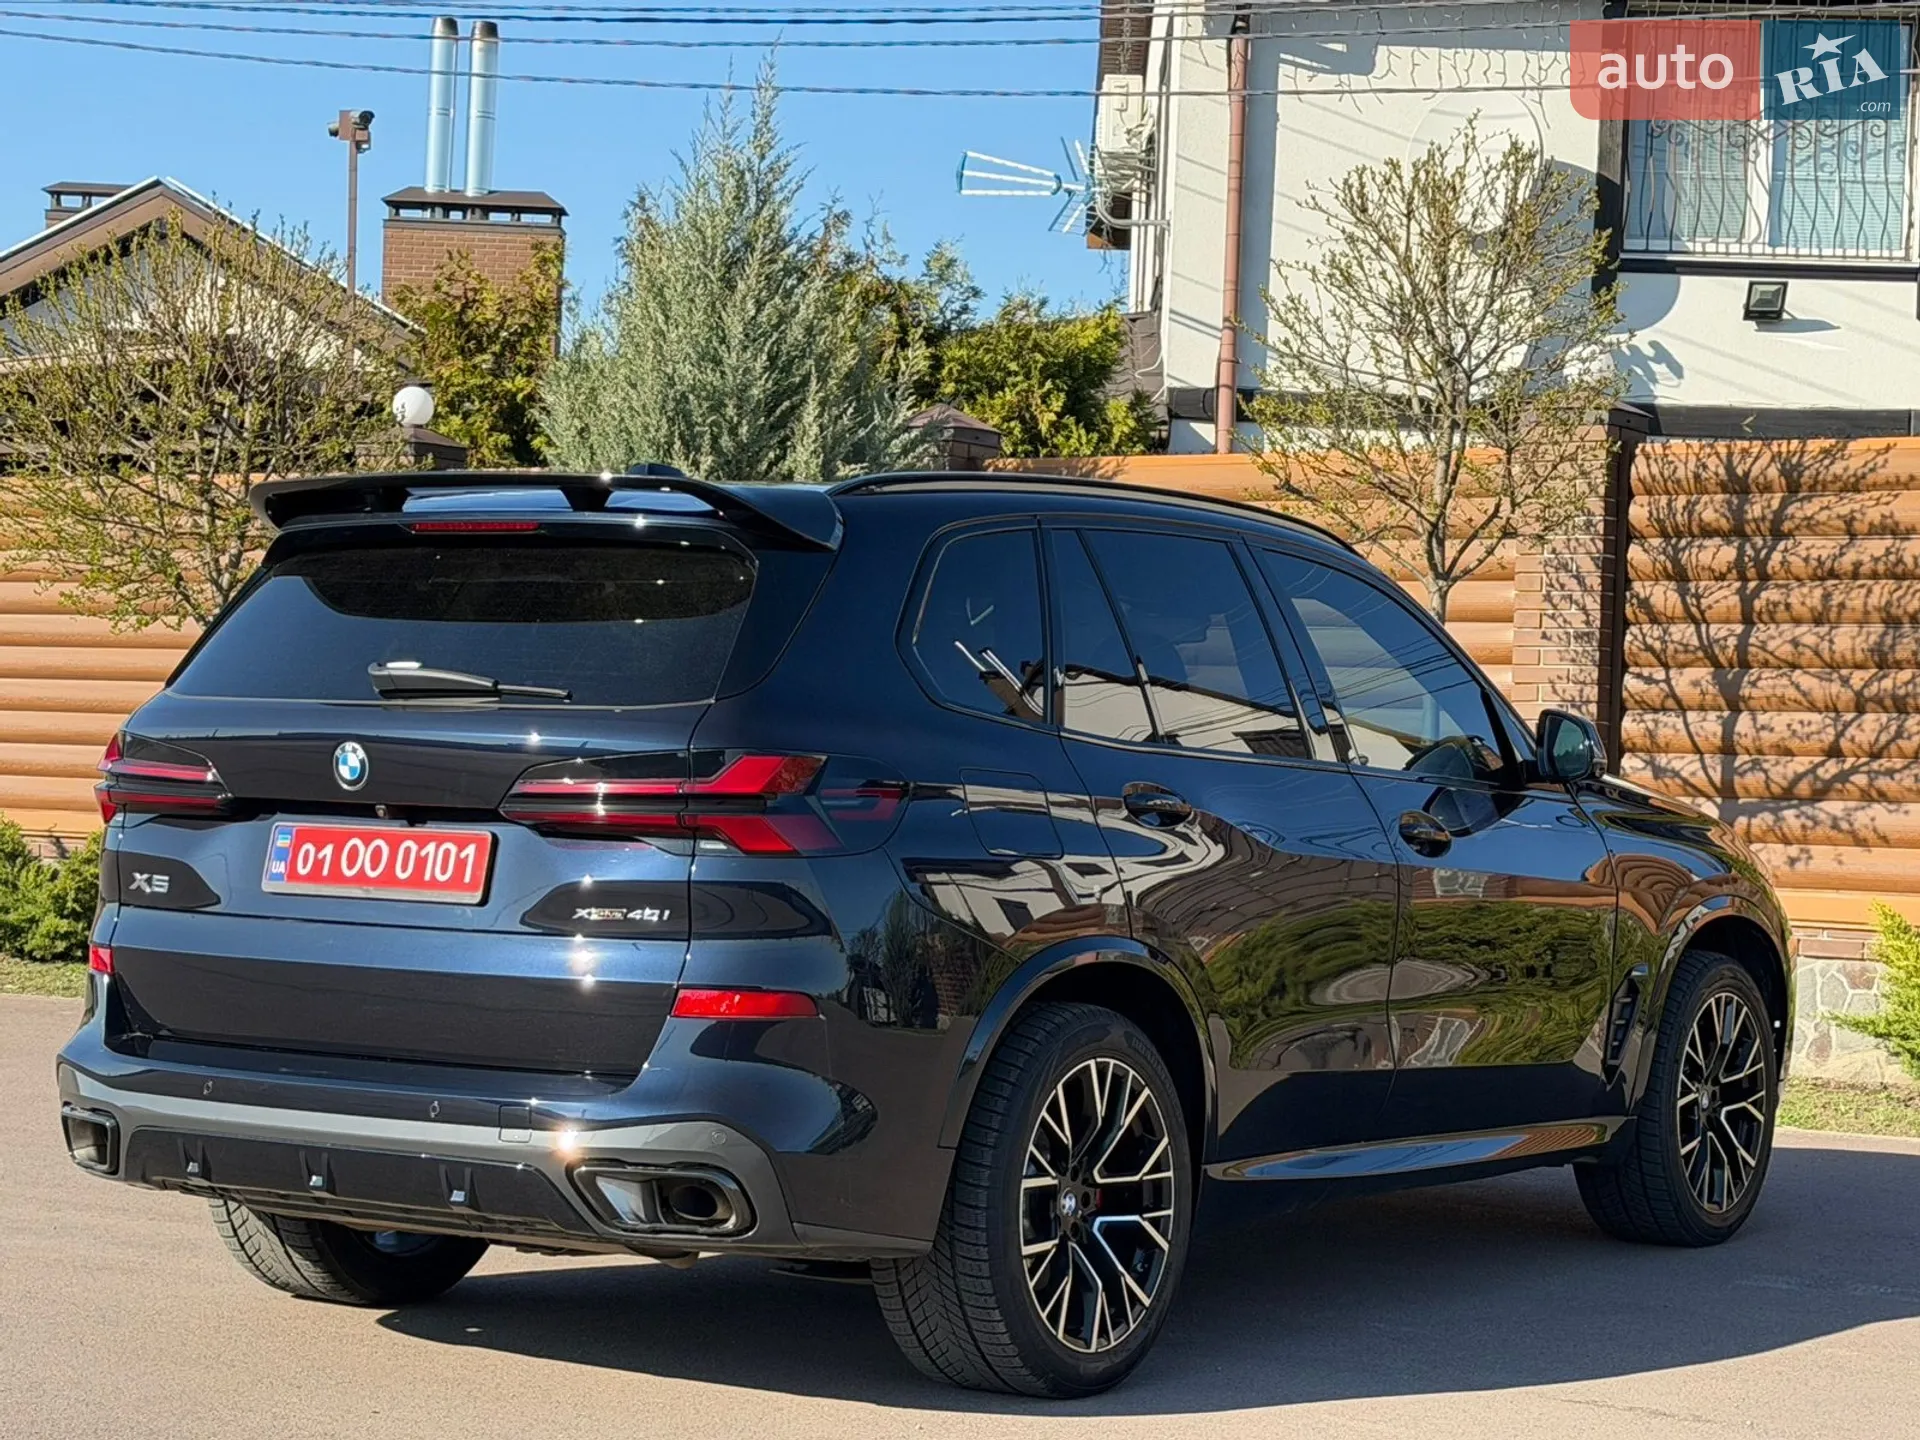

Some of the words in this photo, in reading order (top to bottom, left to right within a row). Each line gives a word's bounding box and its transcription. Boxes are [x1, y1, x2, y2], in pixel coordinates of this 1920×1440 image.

[271, 861, 286, 874] UA
[296, 842, 335, 877] 01
[395, 839, 478, 884] 0101
[128, 872, 170, 893] X5
